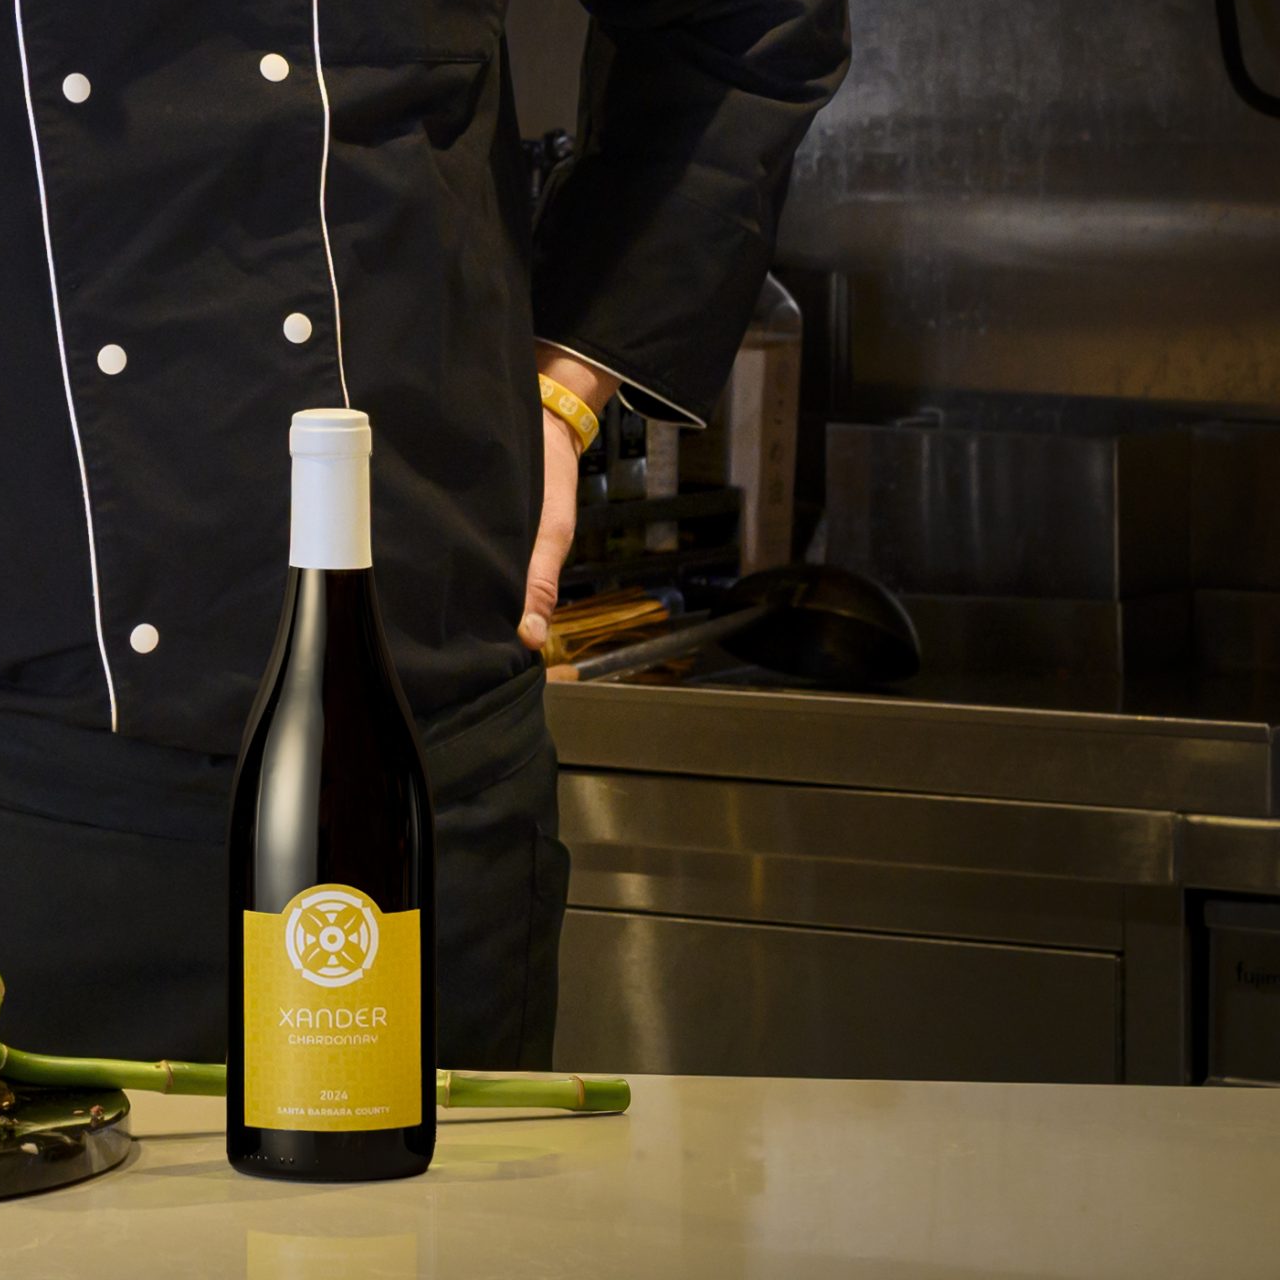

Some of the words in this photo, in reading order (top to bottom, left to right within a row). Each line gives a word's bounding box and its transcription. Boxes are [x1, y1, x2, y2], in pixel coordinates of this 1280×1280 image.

[279, 1006, 388, 1029] XANDER
[288, 1033, 379, 1046] CHARDONNAY
[277, 1106, 306, 1116] SANTA
[307, 1107, 353, 1117] BARBARA
[354, 1105, 391, 1117] COUNTY
